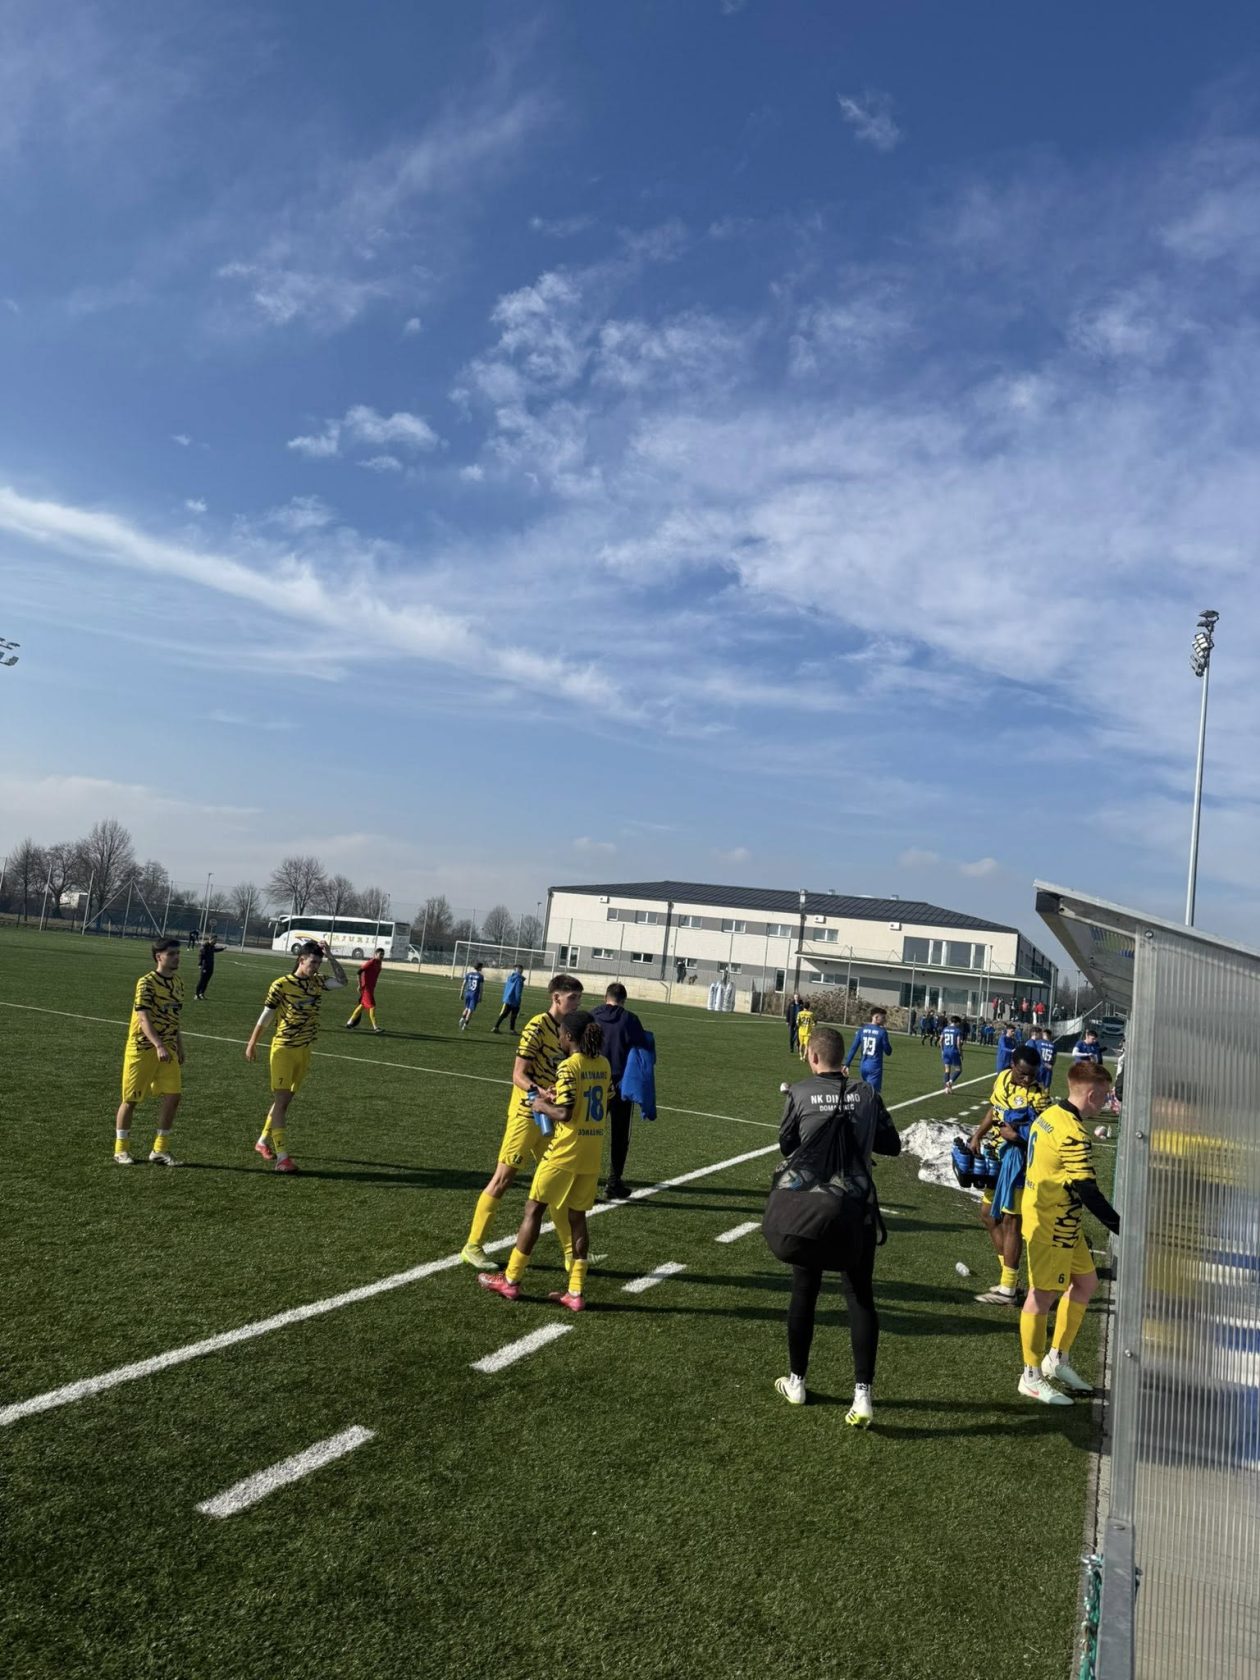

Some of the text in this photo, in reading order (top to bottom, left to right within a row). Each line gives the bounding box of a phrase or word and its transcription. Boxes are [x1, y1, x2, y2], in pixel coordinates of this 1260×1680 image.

[944, 1033, 954, 1046] 21
[583, 1085, 604, 1122] 18
[810, 1094, 823, 1104] NK
[1057, 1273, 1066, 1285] 6
